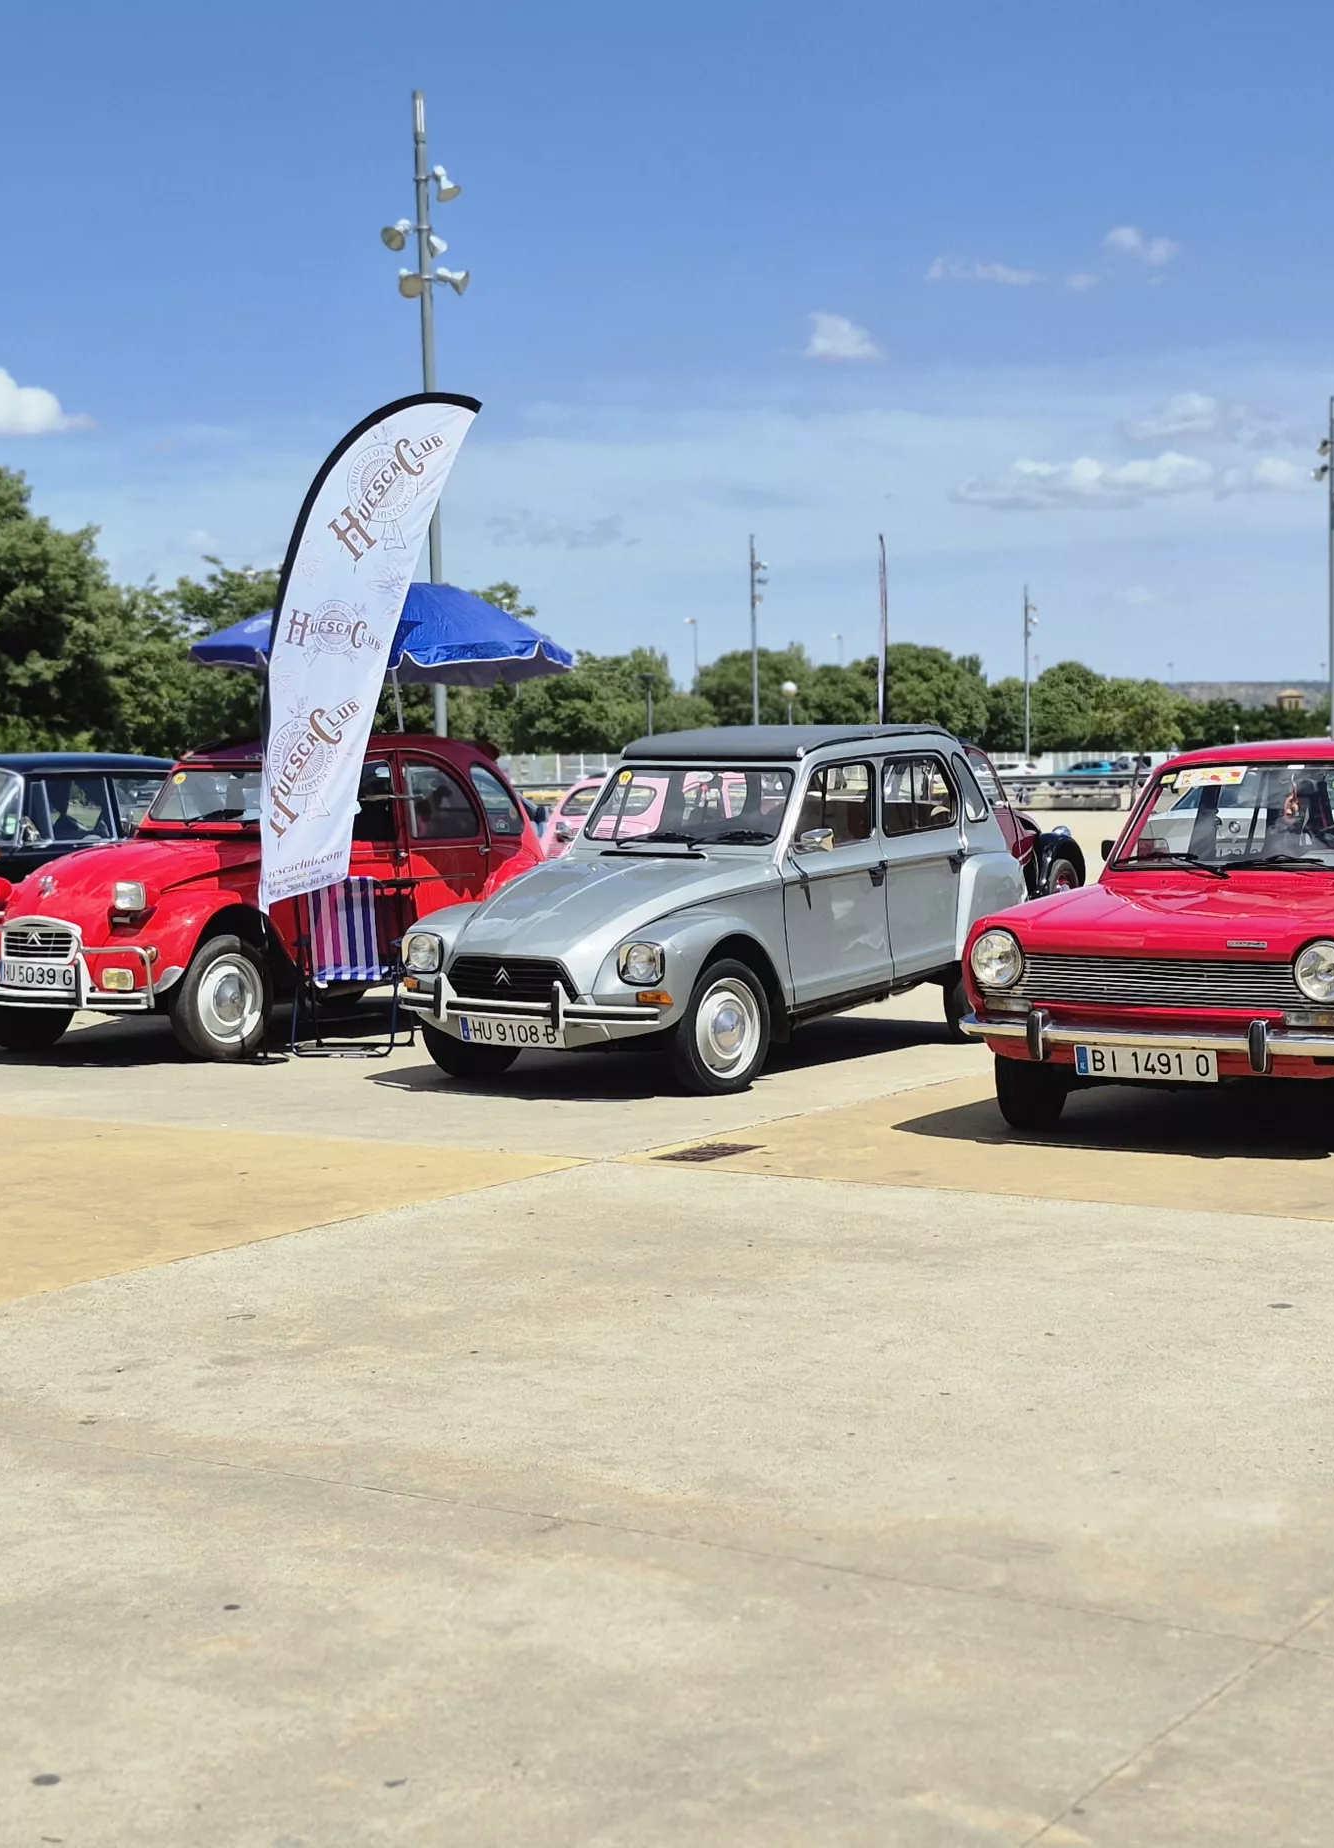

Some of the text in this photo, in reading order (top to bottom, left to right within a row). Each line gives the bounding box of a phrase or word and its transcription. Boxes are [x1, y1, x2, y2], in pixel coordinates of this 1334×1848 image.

[19, 965, 56, 985] 5039
[62, 968, 73, 986] G
[496, 1023, 540, 1043] 9108
[1091, 1049, 1117, 1073] BI
[1131, 1051, 1183, 1076] 1491
